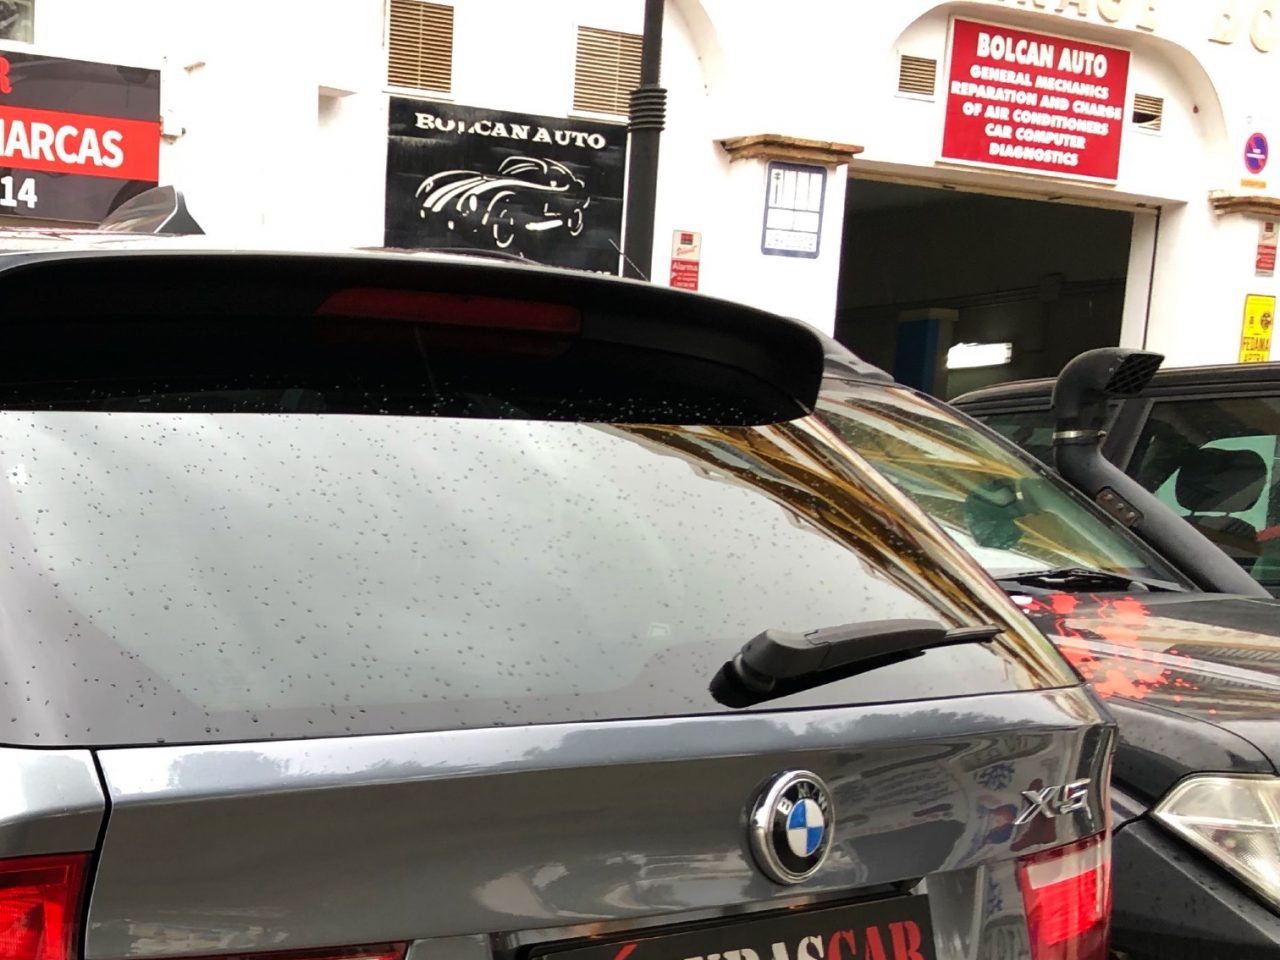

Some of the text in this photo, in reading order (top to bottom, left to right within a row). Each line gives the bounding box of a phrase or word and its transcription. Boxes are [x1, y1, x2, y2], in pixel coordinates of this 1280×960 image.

[976, 31, 1108, 79] BOLCAN AUTO
[950, 80, 1123, 121] REPARATION AND CHARGE
[969, 64, 1110, 101] GENERAL MECHANICS
[961, 101, 1110, 137] OF AIR CONDITIONERS
[984, 123, 1087, 150] CAR COMPUTER
[531, 125, 608, 151] AUTO
[988, 142, 1079, 168] DIAGNOSTICS
[1014, 777, 1092, 825] X5
